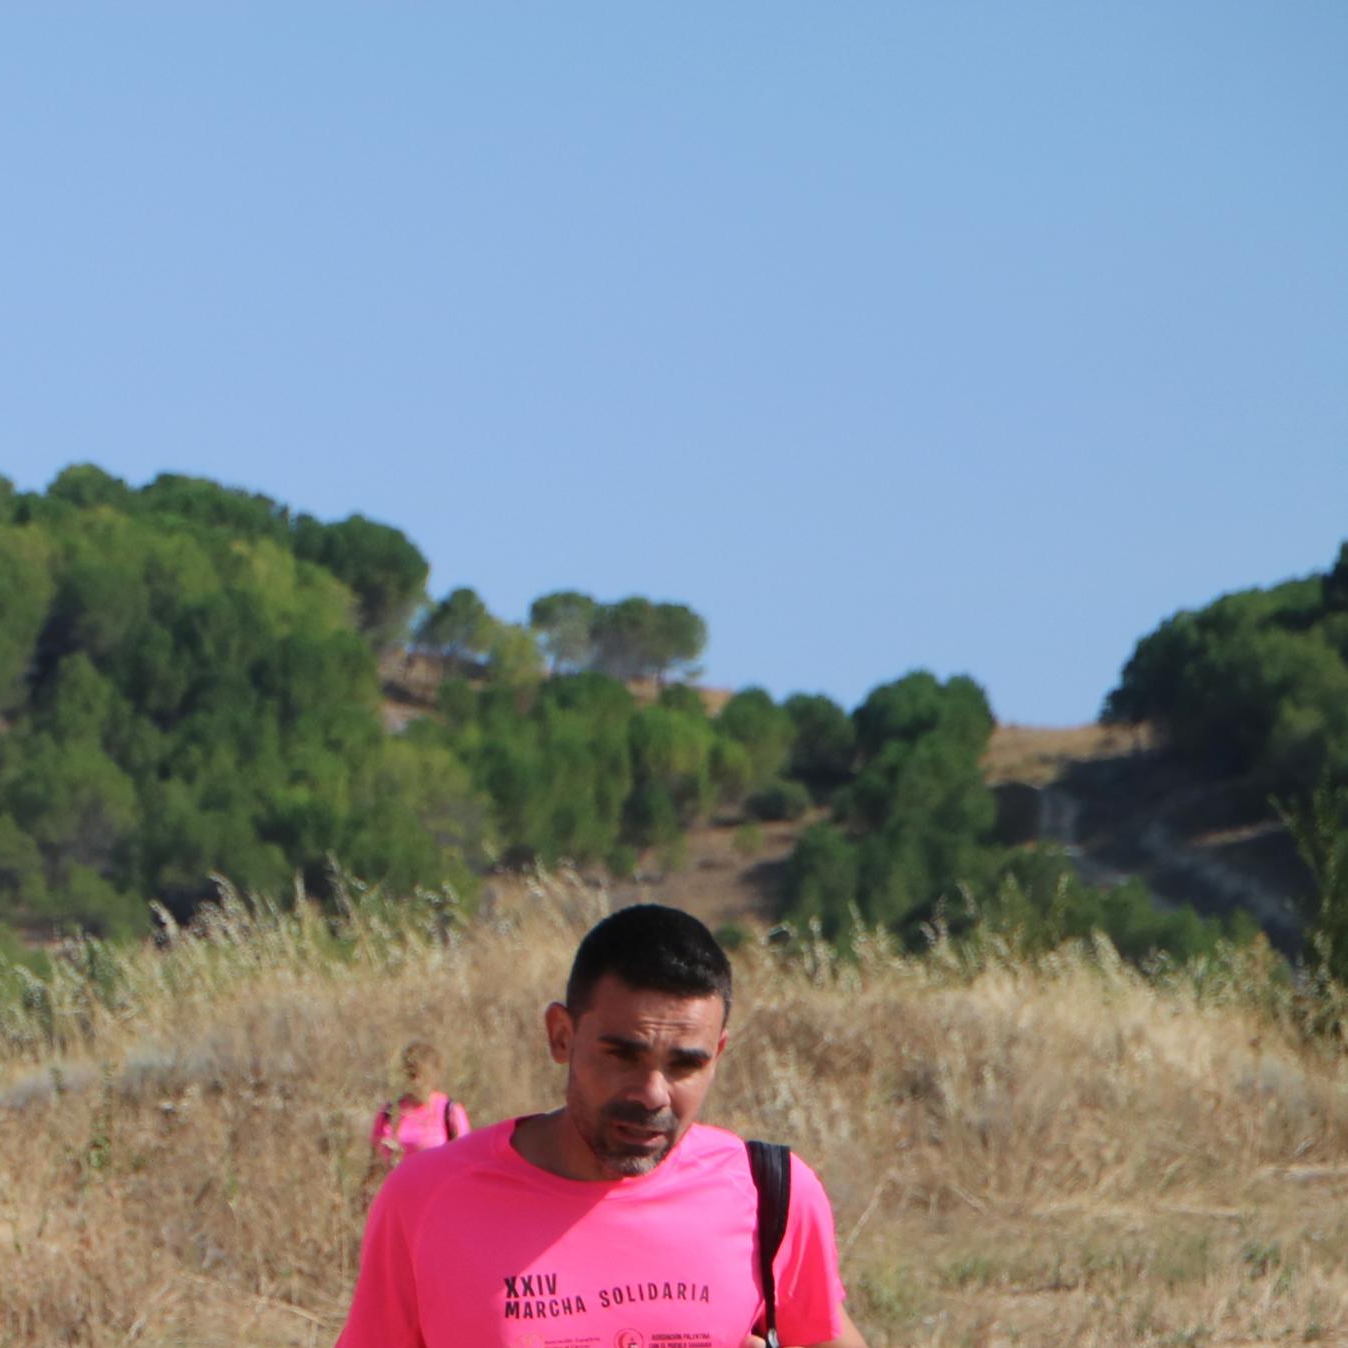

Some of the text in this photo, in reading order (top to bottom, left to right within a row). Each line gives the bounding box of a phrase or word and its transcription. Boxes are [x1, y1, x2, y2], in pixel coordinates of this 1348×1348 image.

[503, 1272, 557, 1299] XXIV
[504, 1281, 711, 1320] MARCHA SOLIDARIA
